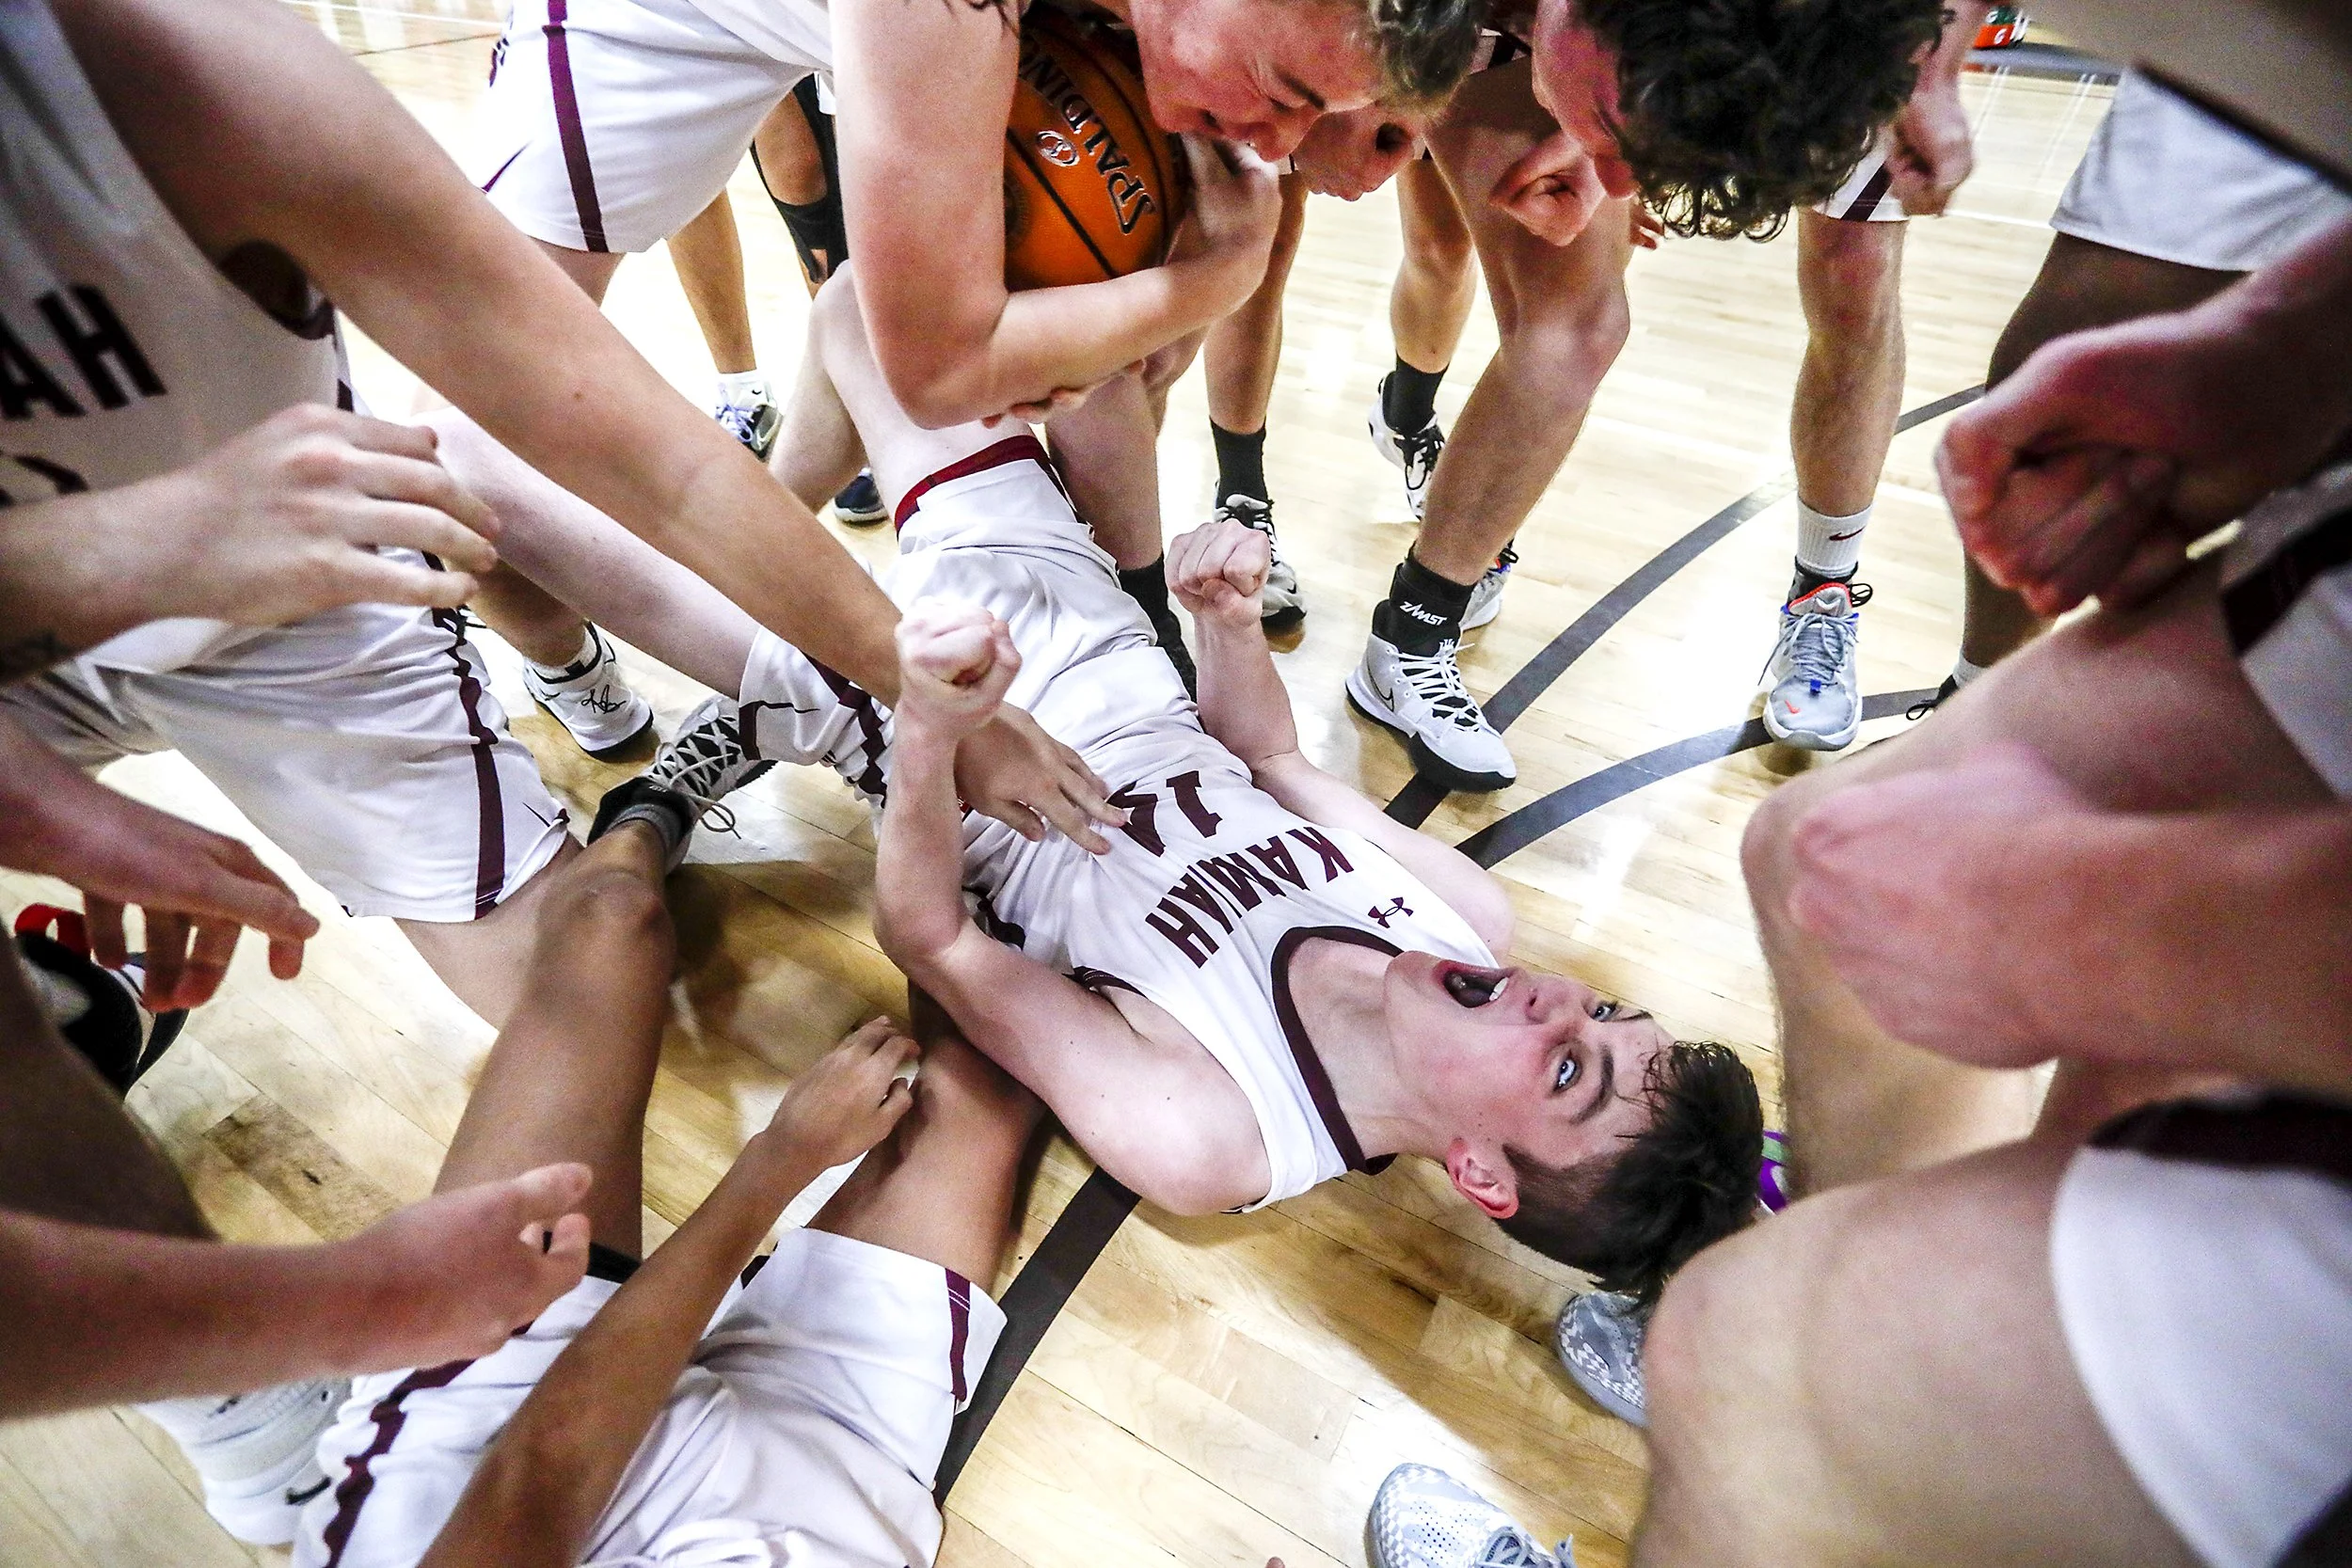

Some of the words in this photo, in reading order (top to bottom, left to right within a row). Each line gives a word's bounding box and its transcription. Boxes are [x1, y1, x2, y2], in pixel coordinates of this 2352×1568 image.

[1994, 28, 2007, 44] G
[1399, 601, 1448, 626] ZAMST
[1145, 826, 1355, 969] KAMIAH
